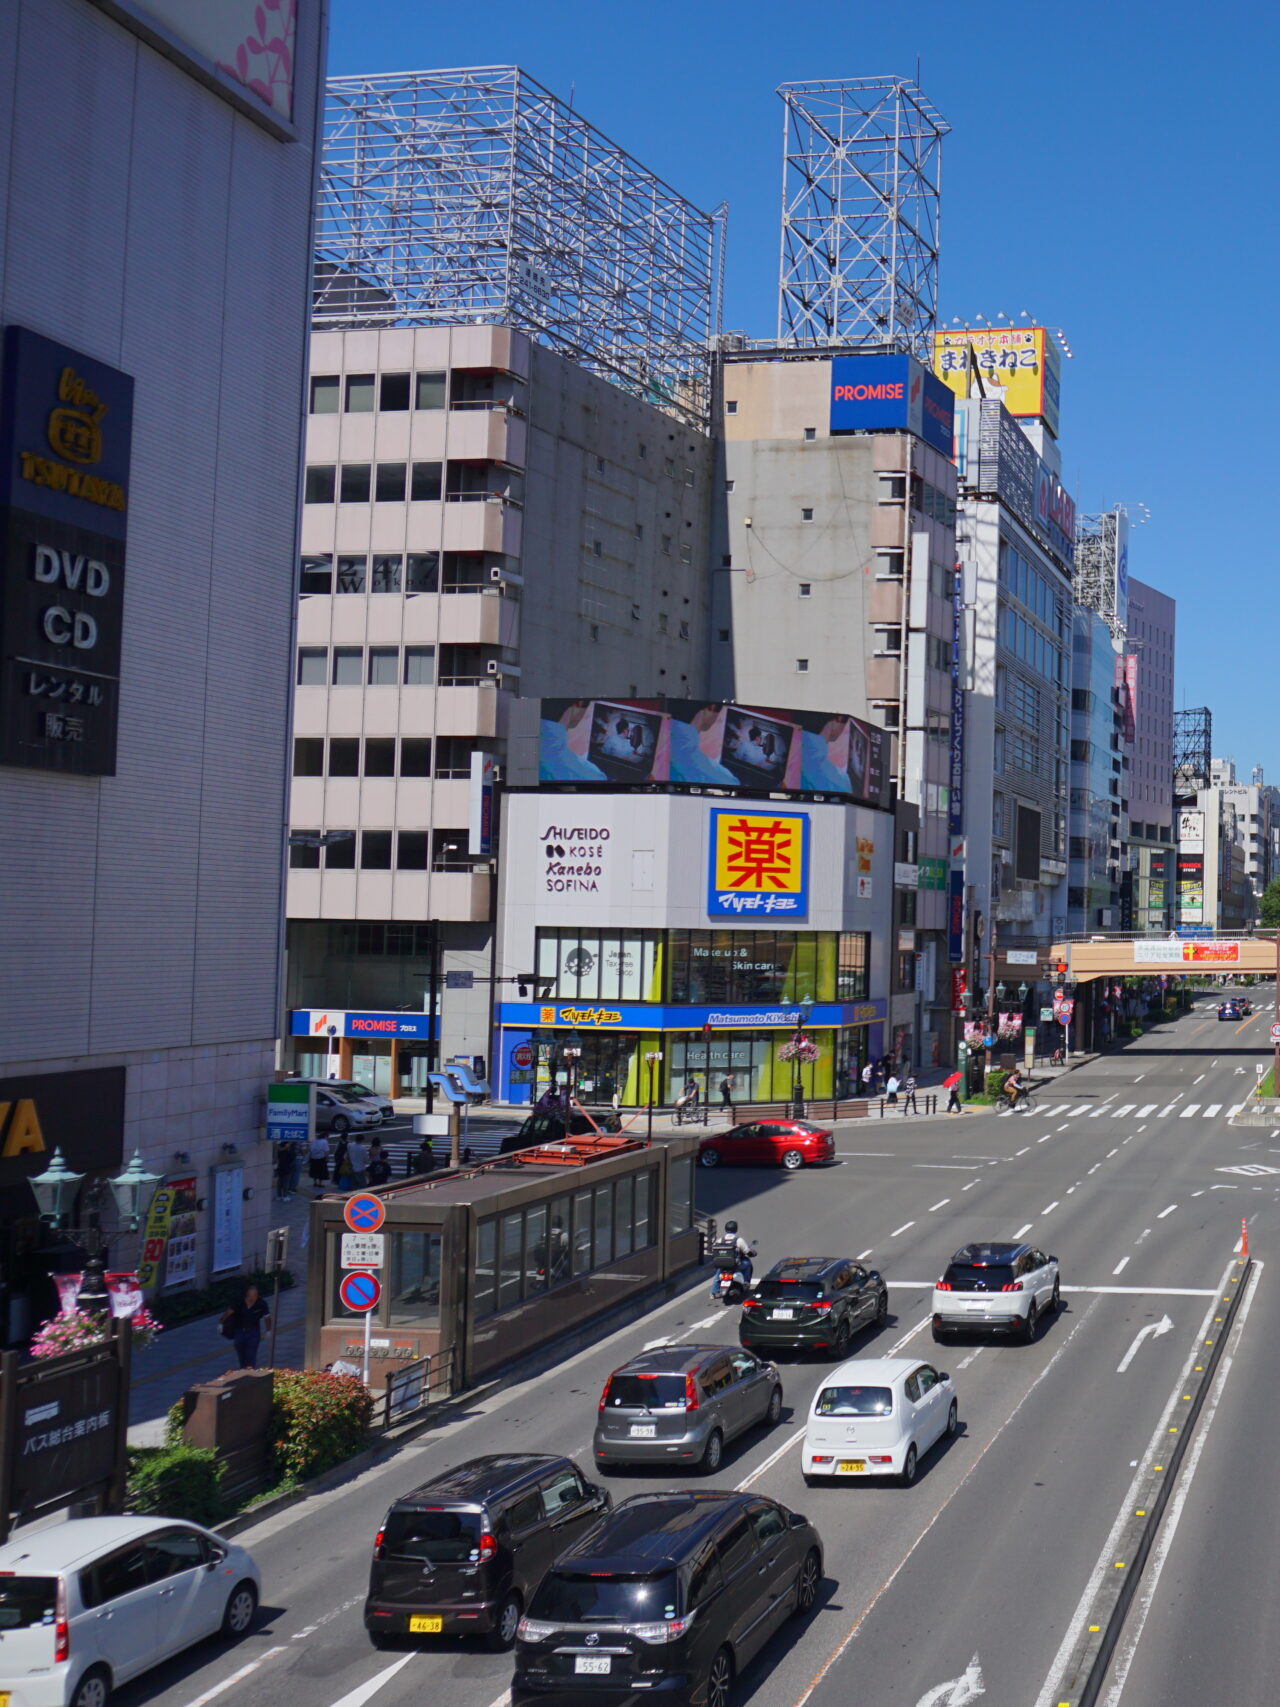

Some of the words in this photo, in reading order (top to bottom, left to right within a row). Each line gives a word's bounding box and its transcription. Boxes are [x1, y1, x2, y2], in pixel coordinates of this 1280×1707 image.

[834, 383, 905, 401] PROMISE
[19, 451, 127, 512] TSUTAYA
[33, 543, 111, 598] DVD
[41, 605, 99, 650] CD
[28, 671, 103, 707] レンタル
[46, 711, 84, 742] 販売
[540, 825, 610, 841] SHISEIDO
[569, 844, 603, 858] KOSÉ
[727, 818, 792, 889] 薬
[546, 861, 602, 876] Kanebo
[546, 878, 599, 893] SOFINA
[718, 892, 798, 913] マツモトキヨシ
[740, 948, 748, 957] &
[733, 961, 753, 970] Skin
[560, 1006, 622, 1025] マツモトキヨシ
[708, 1013, 766, 1024] Matsumoto
[352, 1019, 398, 1032] PROMISE
[687, 1050, 721, 1060] Heath
[268, 1109, 309, 1119] FamilyMart
[24, 1409, 111, 1457] バス総合案内板
